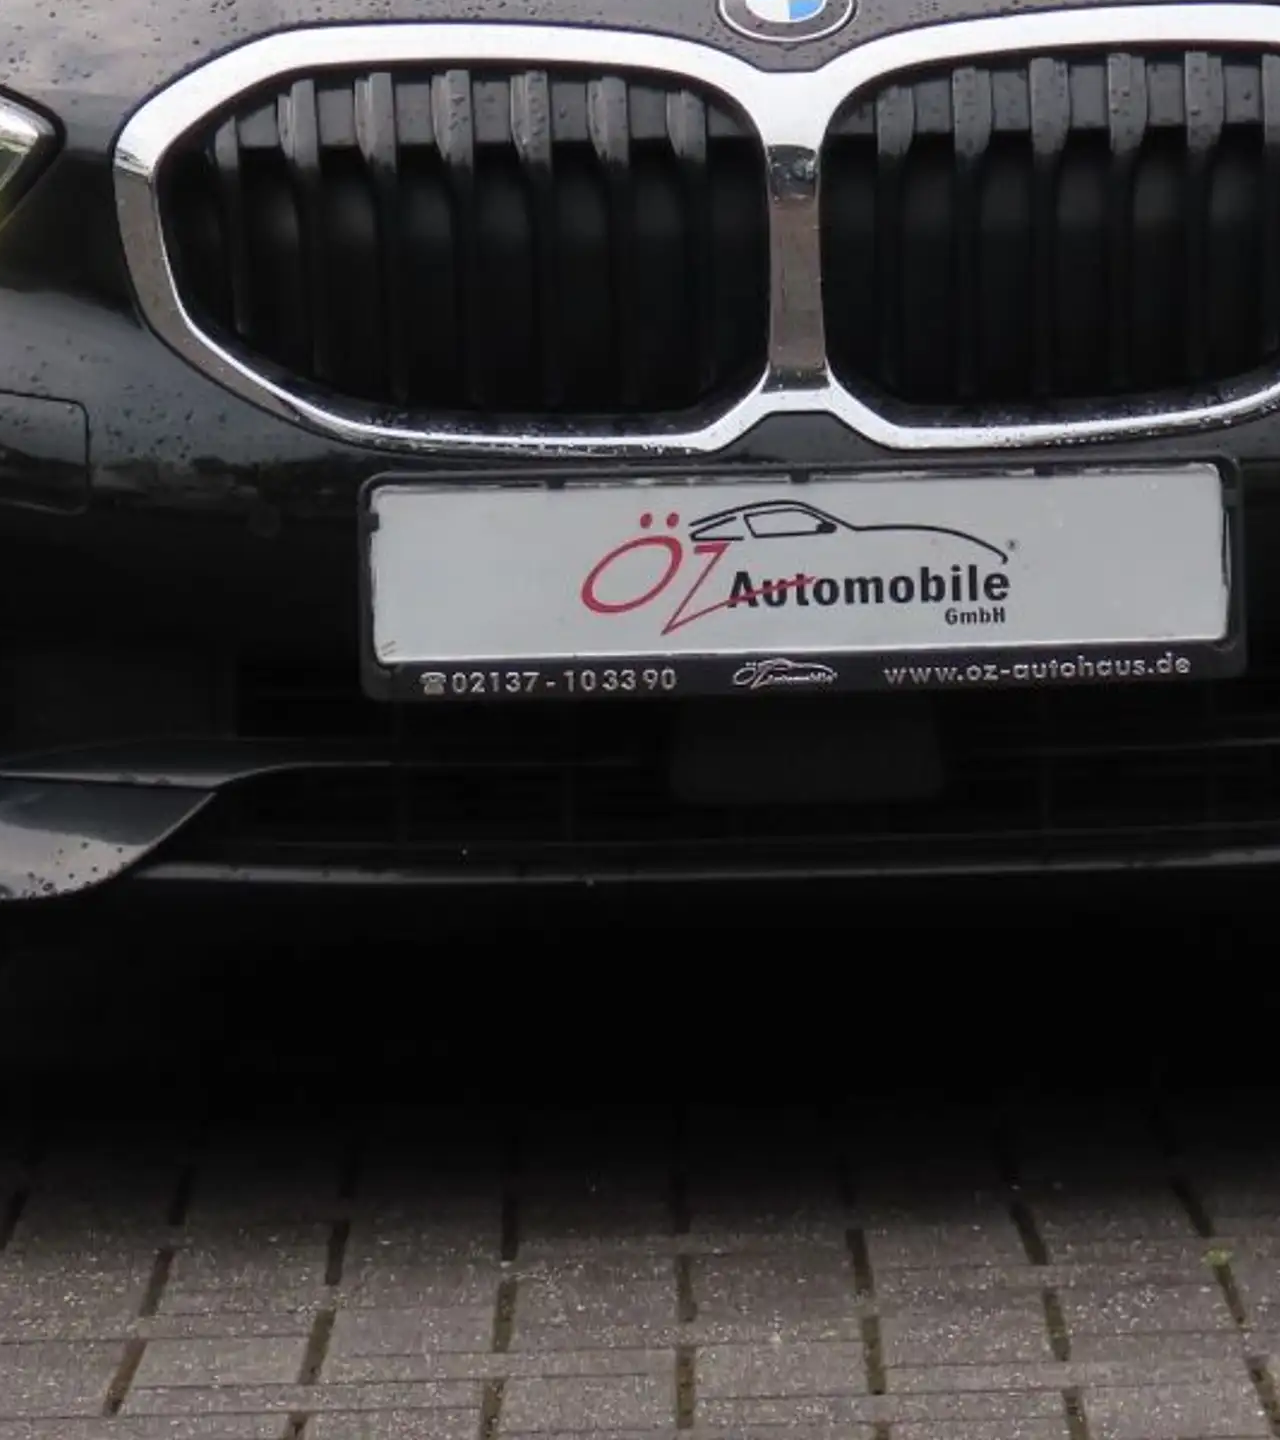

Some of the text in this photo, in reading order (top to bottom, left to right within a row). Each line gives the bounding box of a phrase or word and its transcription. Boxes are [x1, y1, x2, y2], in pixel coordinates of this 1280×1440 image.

[581, 512, 1010, 635] ÖZ Automobile
[944, 606, 1006, 626] GmbH
[883, 651, 1191, 685] www.oz-autohaus.de
